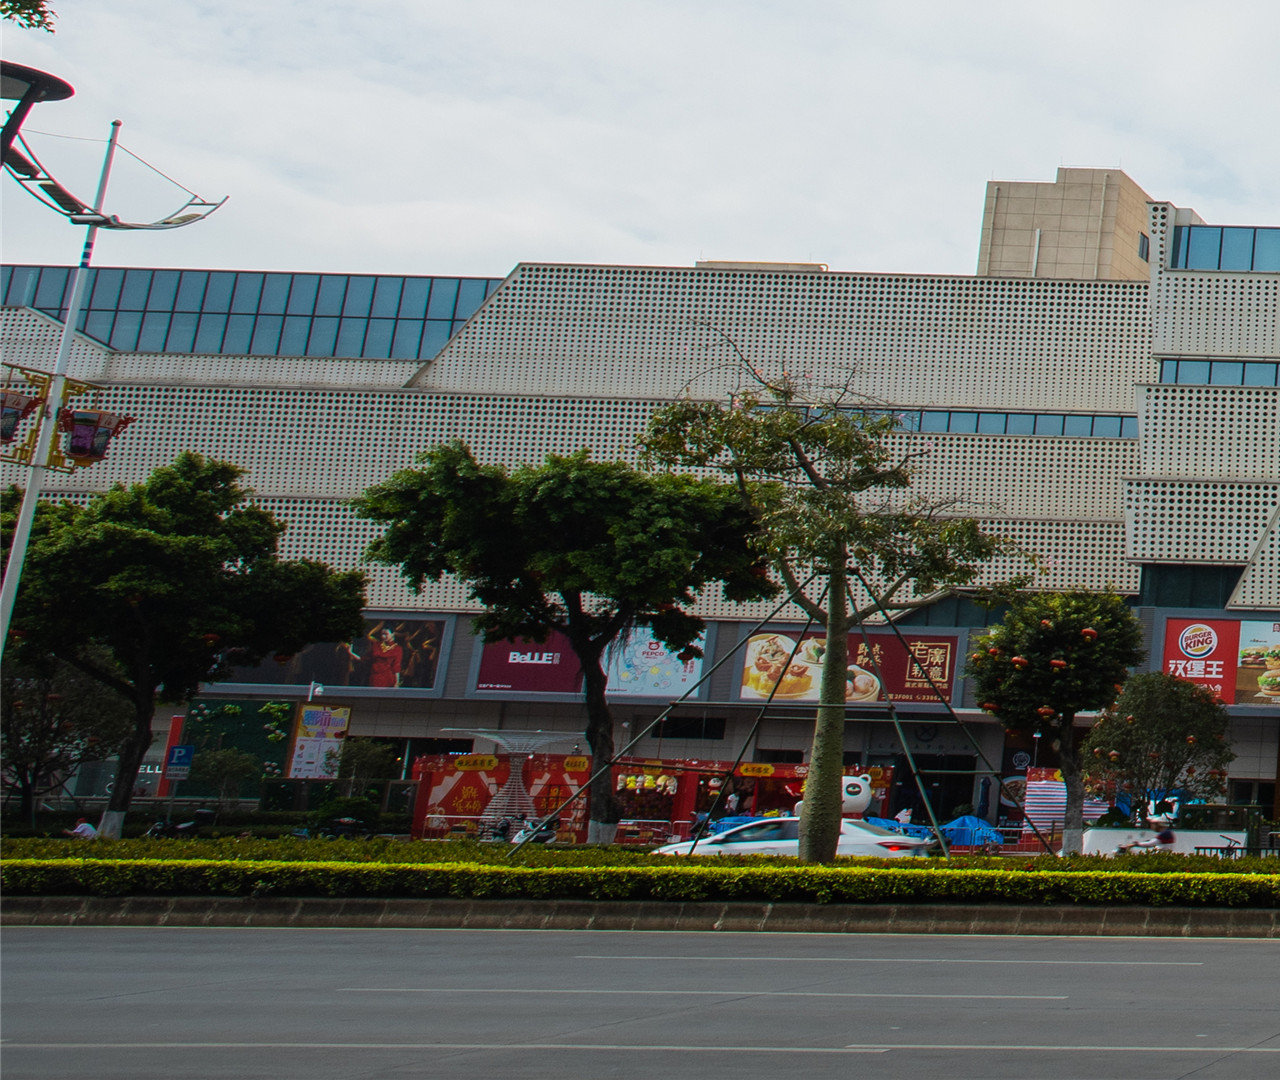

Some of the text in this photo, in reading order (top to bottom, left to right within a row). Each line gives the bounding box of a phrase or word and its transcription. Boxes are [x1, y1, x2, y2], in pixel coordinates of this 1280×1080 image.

[1184, 631, 1212, 642] BURGER
[1184, 637, 1213, 650] KING
[1169, 660, 1224, 678] 汉堡王
[172, 748, 186, 764] P
